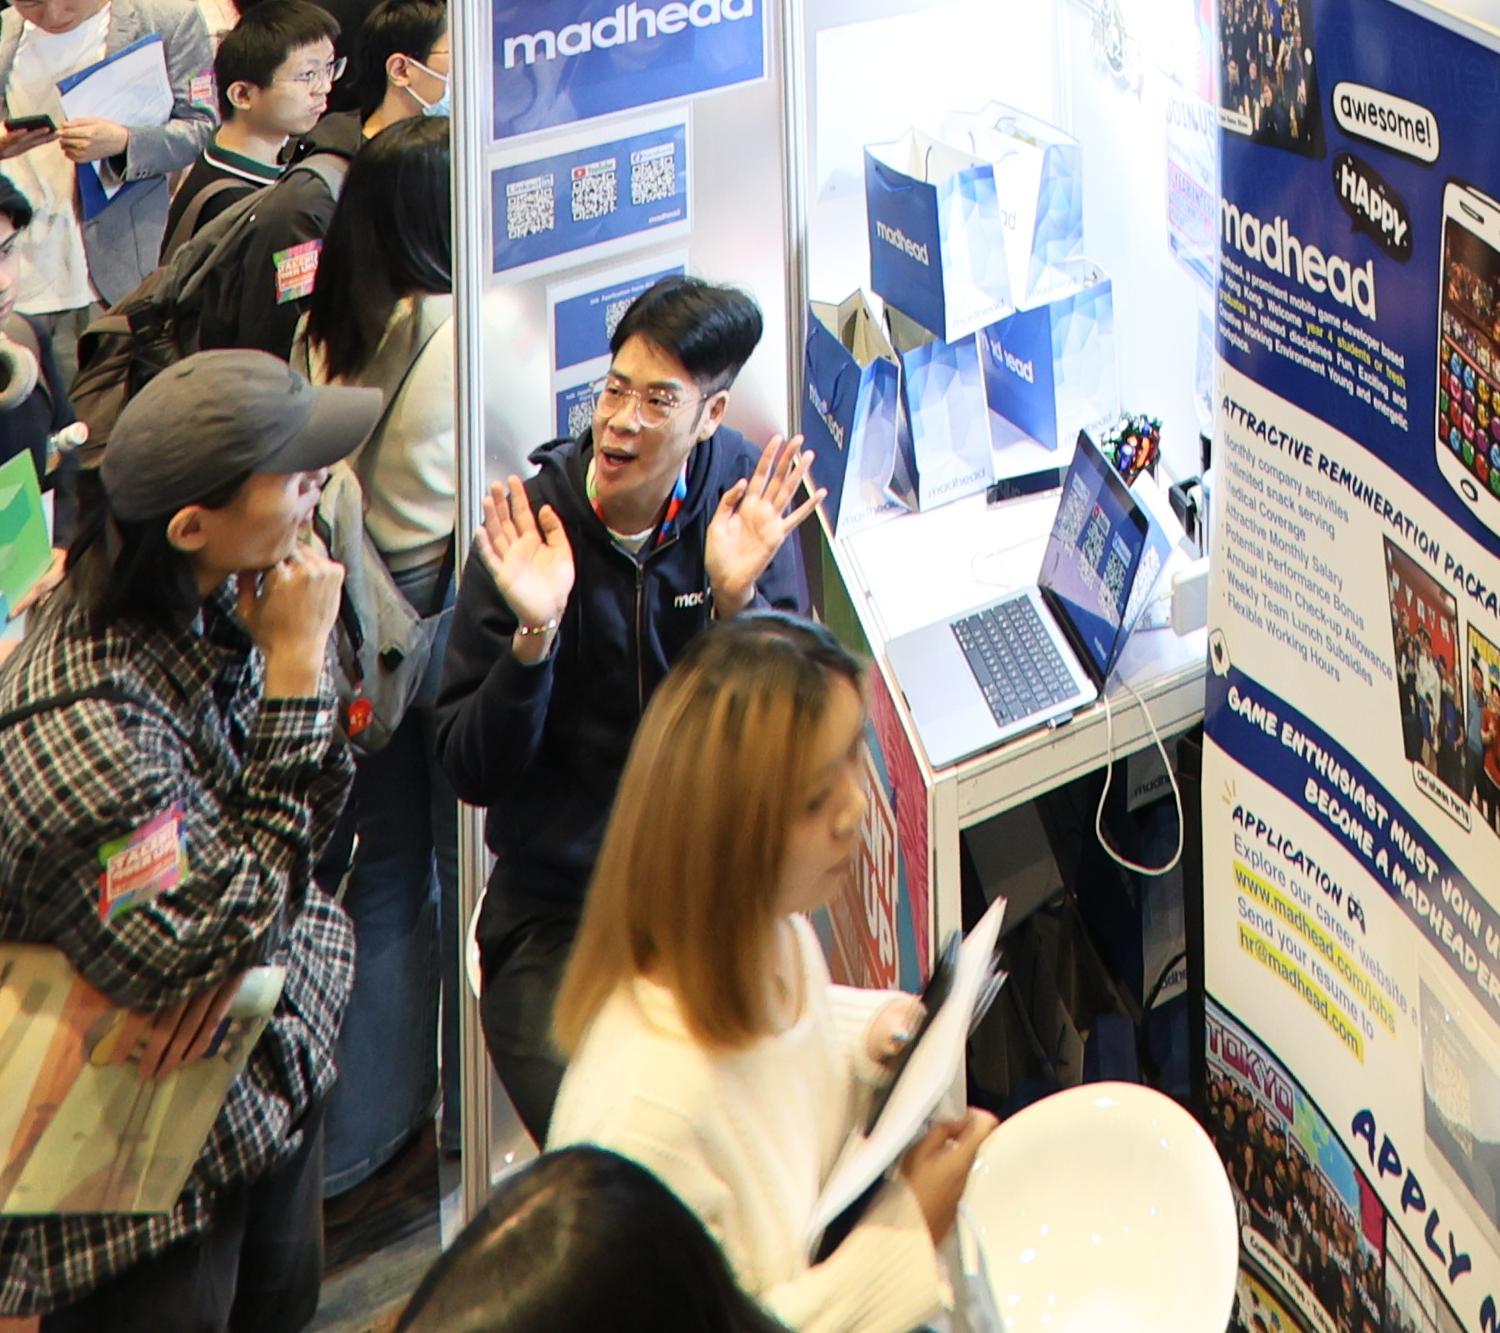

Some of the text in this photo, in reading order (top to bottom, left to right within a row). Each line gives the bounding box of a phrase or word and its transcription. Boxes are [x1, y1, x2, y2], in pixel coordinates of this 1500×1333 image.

[1340, 93, 1432, 146] awesome!
[876, 220, 930, 267] madhead
[1219, 196, 1377, 322] madhead
[1340, 164, 1408, 247] HAPPY
[1219, 323, 1249, 355] workplace.
[1219, 303, 1407, 434] Creative Working Environment Young and energetic
[1224, 273, 1405, 390] Hong Kong. Welcome year 4 students or fresh
[1252, 272, 1404, 369] prominent mobile game developer based
[1260, 311, 1406, 411] related disciplines Fun, Exciting and
[927, 468, 987, 501] madhead
[1222, 392, 1312, 468] ATTRACTIVE
[1318, 454, 1438, 566] REMUNERATION
[1223, 452, 1334, 540] Unlimited snack serving
[1258, 457, 1301, 495] company
[1305, 483, 1348, 525] activities
[1259, 499, 1305, 546] Coverage
[1225, 498, 1342, 593] Attractive Monthly Salary
[1225, 520, 1363, 631] Potential Performance Bonus
[1226, 544, 1392, 682] Annual Health Check-up Allowance
[1226, 566, 1372, 689] Weekly Team Lunch Subsidies
[1227, 590, 1339, 684] Flexible Working Hours
[1228, 681, 1276, 739] GAME
[1281, 719, 1388, 837] ENTHUSIAST
[1390, 814, 1439, 890] MUST
[1441, 870, 1481, 942] JOIN
[1232, 798, 1342, 910] APPLICATION
[1234, 831, 1407, 1015] Explore our career website
[1304, 772, 1373, 860] BECOME
[1375, 840, 1388, 879] A
[1392, 855, 1500, 1007] MADHEADER
[1235, 863, 1395, 1035] www.madhead.com/jobs
[1237, 892, 1373, 1042] Send your resume to
[1239, 926, 1358, 1058] hr@madhead.com
[1207, 1018, 1294, 1120] TOKYO
[1351, 1109, 1472, 1284] APPLY
